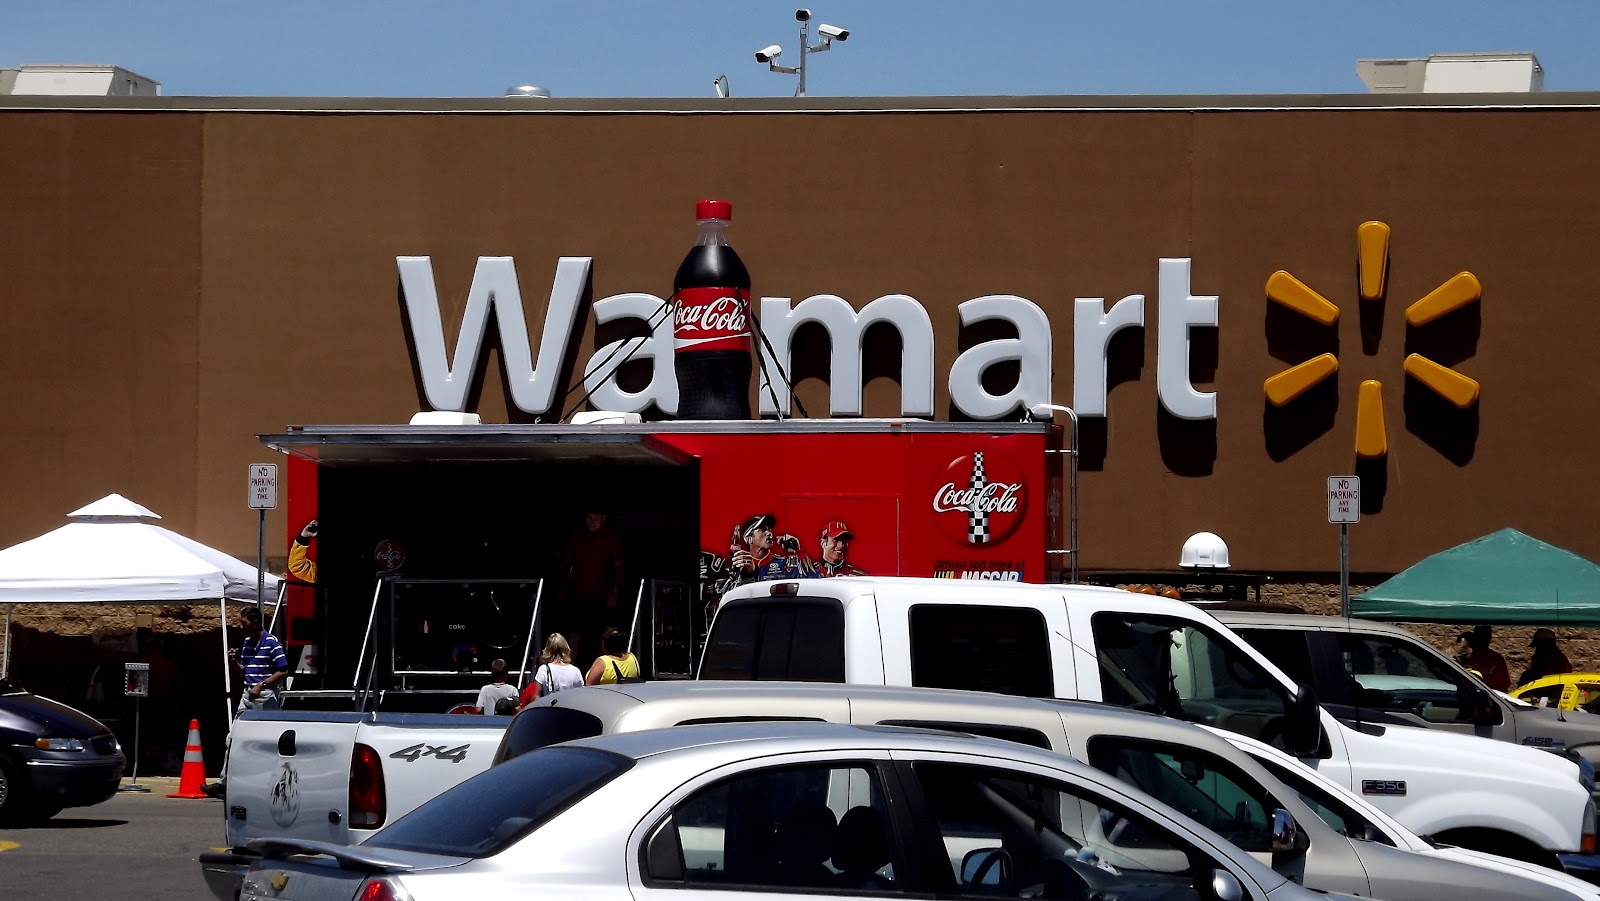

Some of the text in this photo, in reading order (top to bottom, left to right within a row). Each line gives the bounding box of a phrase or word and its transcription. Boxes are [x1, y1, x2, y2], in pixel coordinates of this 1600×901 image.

[396, 255, 1220, 421] Wamart
[258, 467, 268, 477] NO
[251, 477, 275, 487] PARKING
[1338, 480, 1350, 490] NO
[1330, 490, 1358, 500] PARKING
